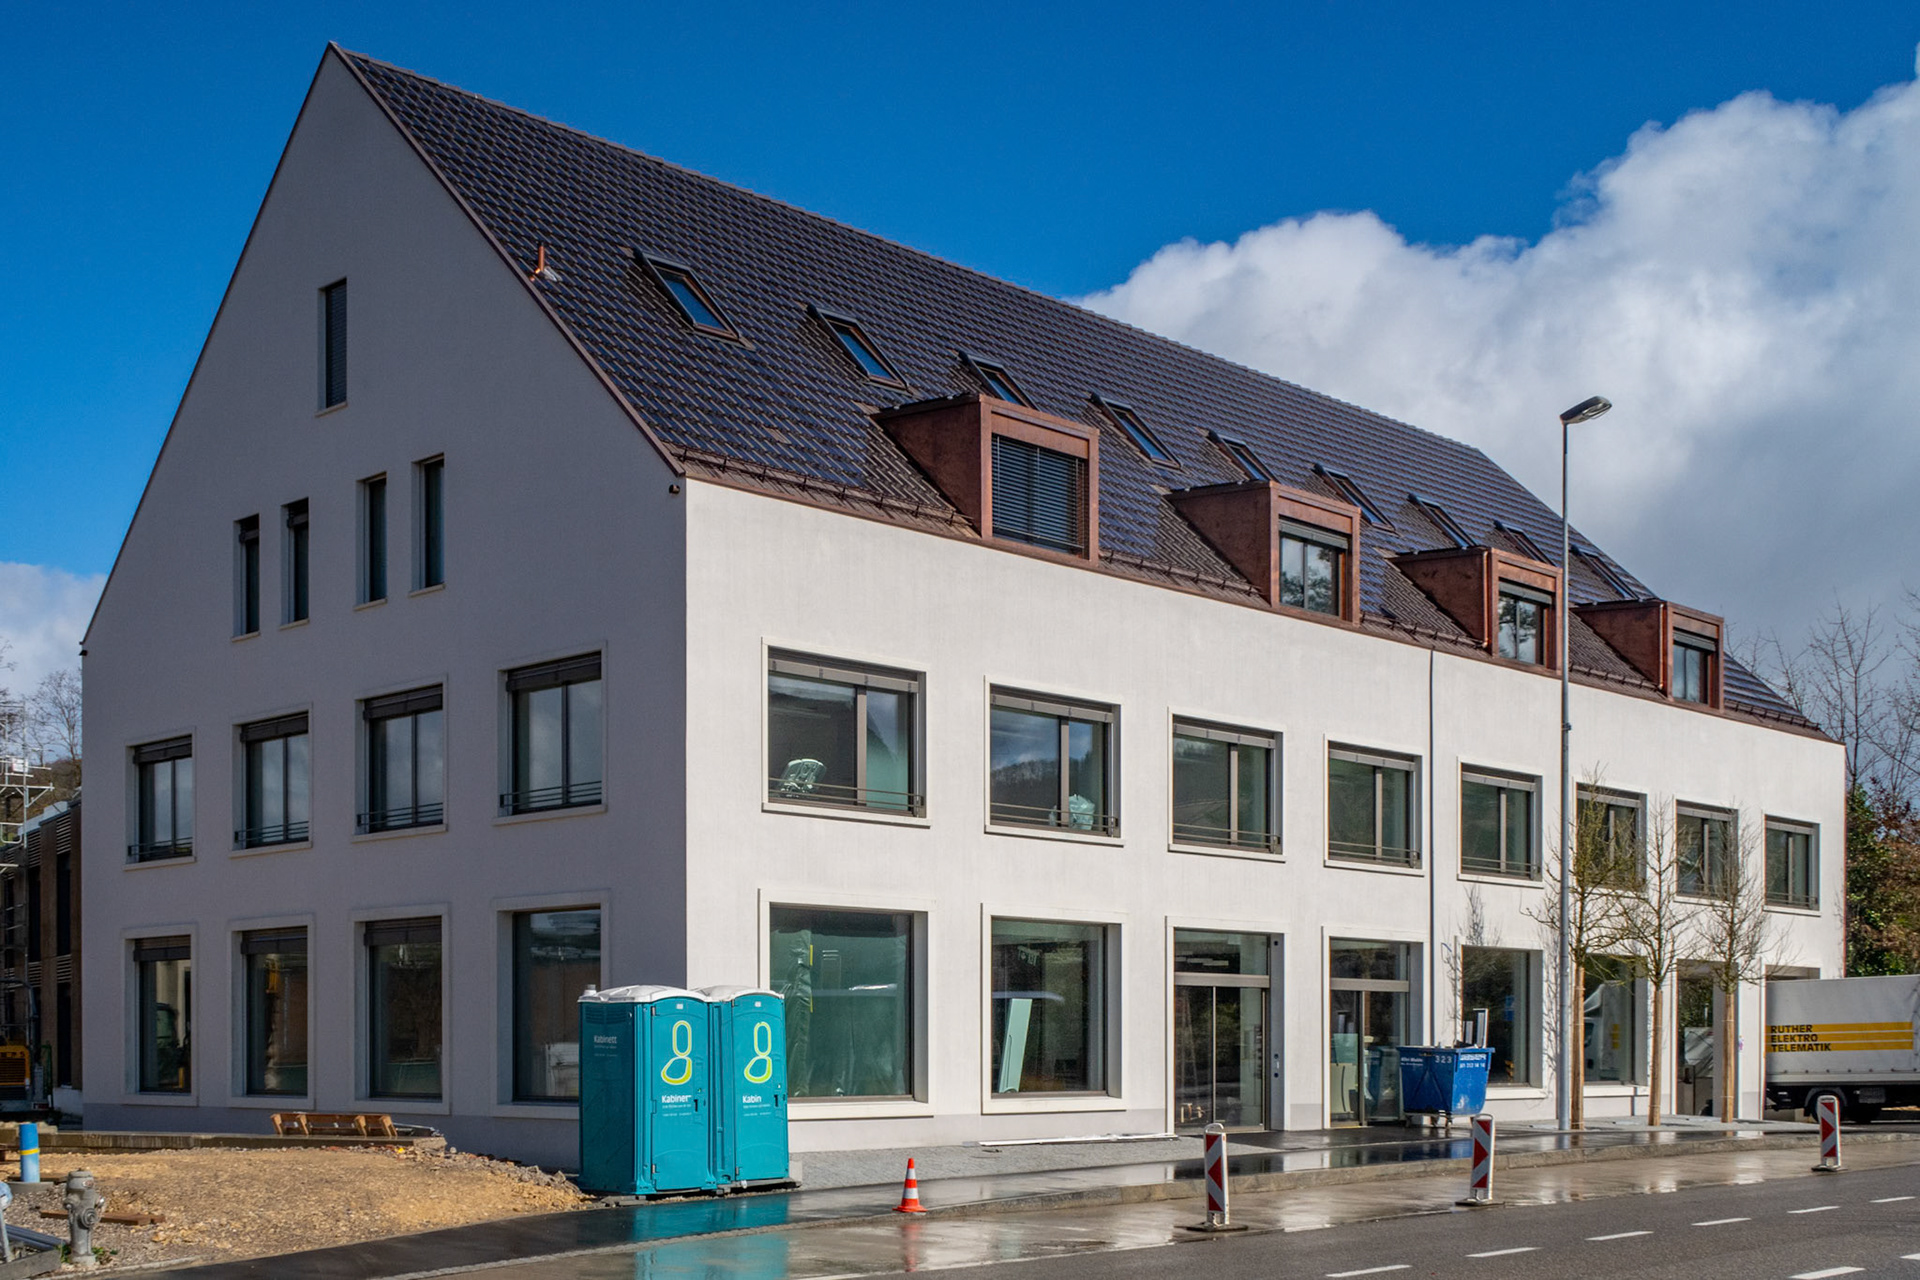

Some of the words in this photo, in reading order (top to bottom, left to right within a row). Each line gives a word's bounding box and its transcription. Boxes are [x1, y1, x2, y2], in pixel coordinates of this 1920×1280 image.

[1770, 1024, 1813, 1033] RUTHER
[1770, 1034, 1818, 1043] ELEKTRO
[1771, 1043, 1831, 1052] TELEMATIK
